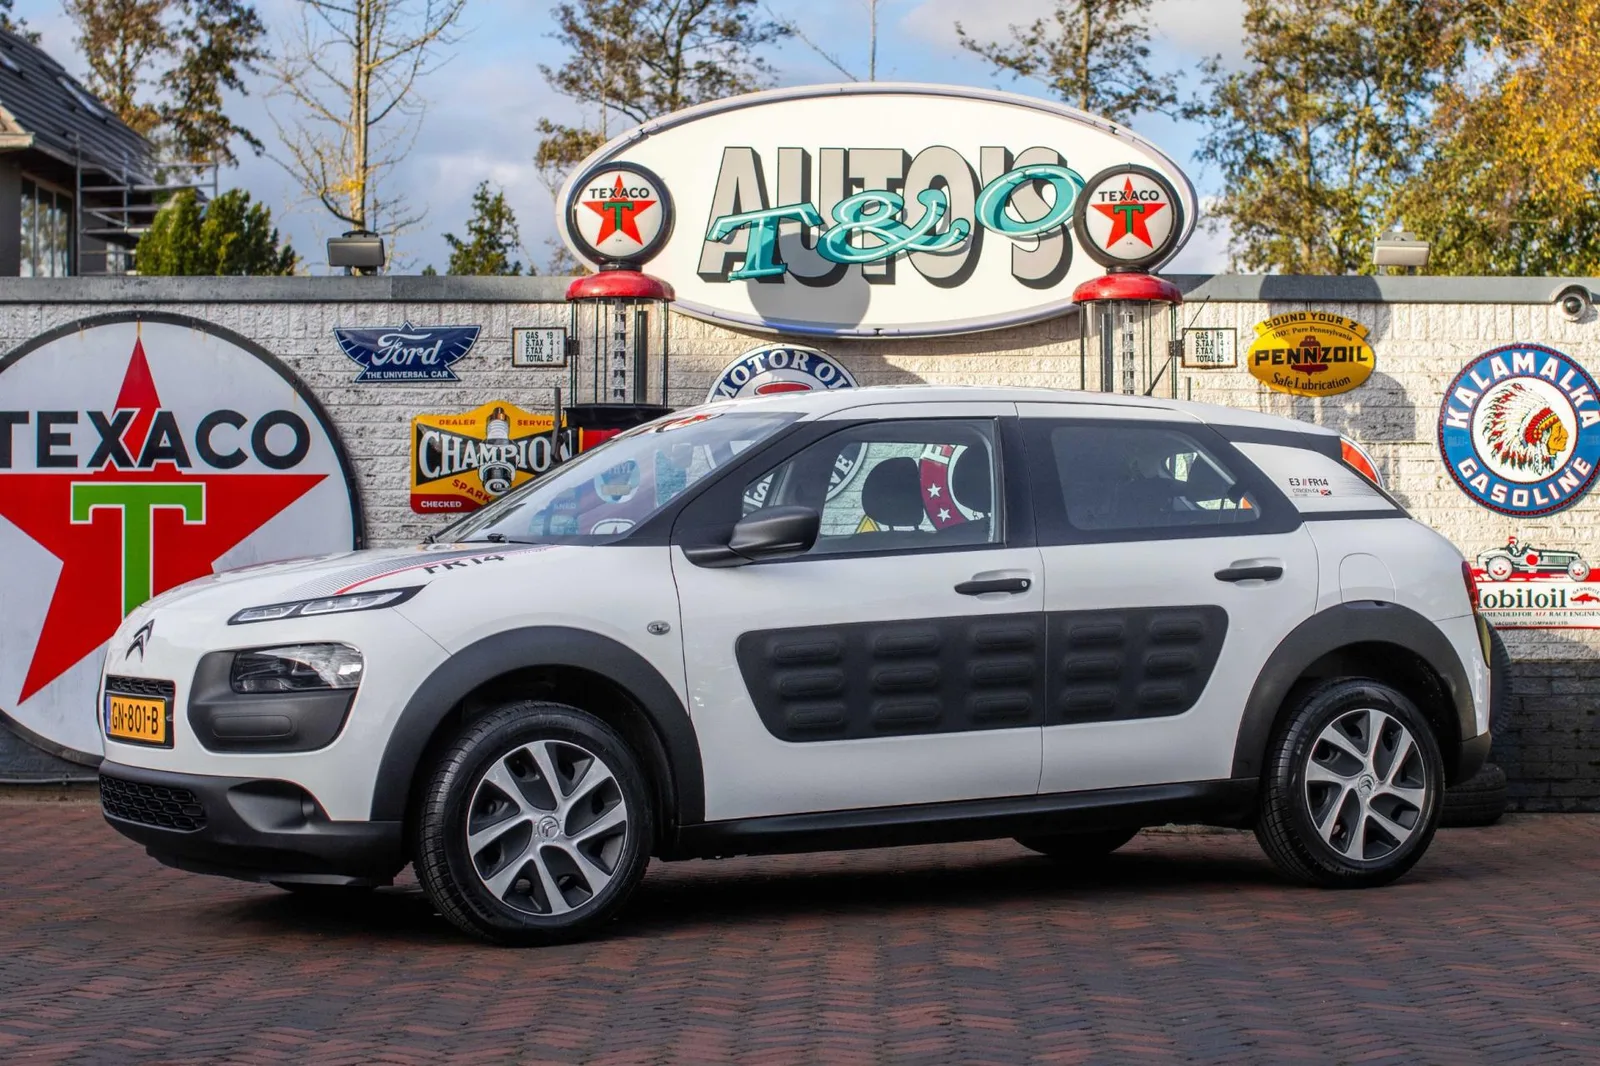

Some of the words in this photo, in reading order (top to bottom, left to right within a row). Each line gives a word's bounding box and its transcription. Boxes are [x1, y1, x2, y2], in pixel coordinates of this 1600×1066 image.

[589, 187, 650, 199] TEXACO
[1098, 190, 1160, 202] TEXACO
[697, 145, 1073, 289] AUTO'S
[1263, 312, 1306, 330] SOUND
[1311, 312, 1344, 326] YOUR
[1348, 321, 1359, 331] Z
[525, 331, 539, 340] GAS
[546, 331, 554, 340] 19
[1195, 331, 1209, 340] GAS
[1216, 331, 1224, 340] 19
[1309, 325, 1353, 341] Pennsylvania
[525, 339, 544, 347] S.TAX
[1195, 339, 1214, 347] S.TAX
[371, 333, 444, 366] Ford
[525, 347, 543, 355] F.TAX
[1195, 347, 1214, 355] F.TAX
[1254, 345, 1369, 366] PENNZOIL
[525, 354, 544, 362] TOTAL
[546, 354, 554, 362] 25
[1195, 355, 1215, 363] TOTAL
[1216, 355, 1225, 363] 25
[366, 371, 382, 379] THE
[383, 371, 429, 379] UNIVERSAL
[430, 371, 449, 379] CAR
[814, 362, 848, 389] OI
[1272, 372, 1293, 389] Safe
[1294, 376, 1352, 391] Lubrication
[1446, 352, 1600, 430] KALAMALKA
[517, 419, 556, 427] SERVIC
[0, 410, 311, 470] TEXACO
[1288, 477, 1301, 487] E3
[1308, 477, 1329, 487] FR14
[1457, 456, 1592, 508] GASOLINE
[451, 478, 492, 503] SPARK
[420, 500, 462, 508] CHECKED
[112, 702, 159, 735] GN-801-B
